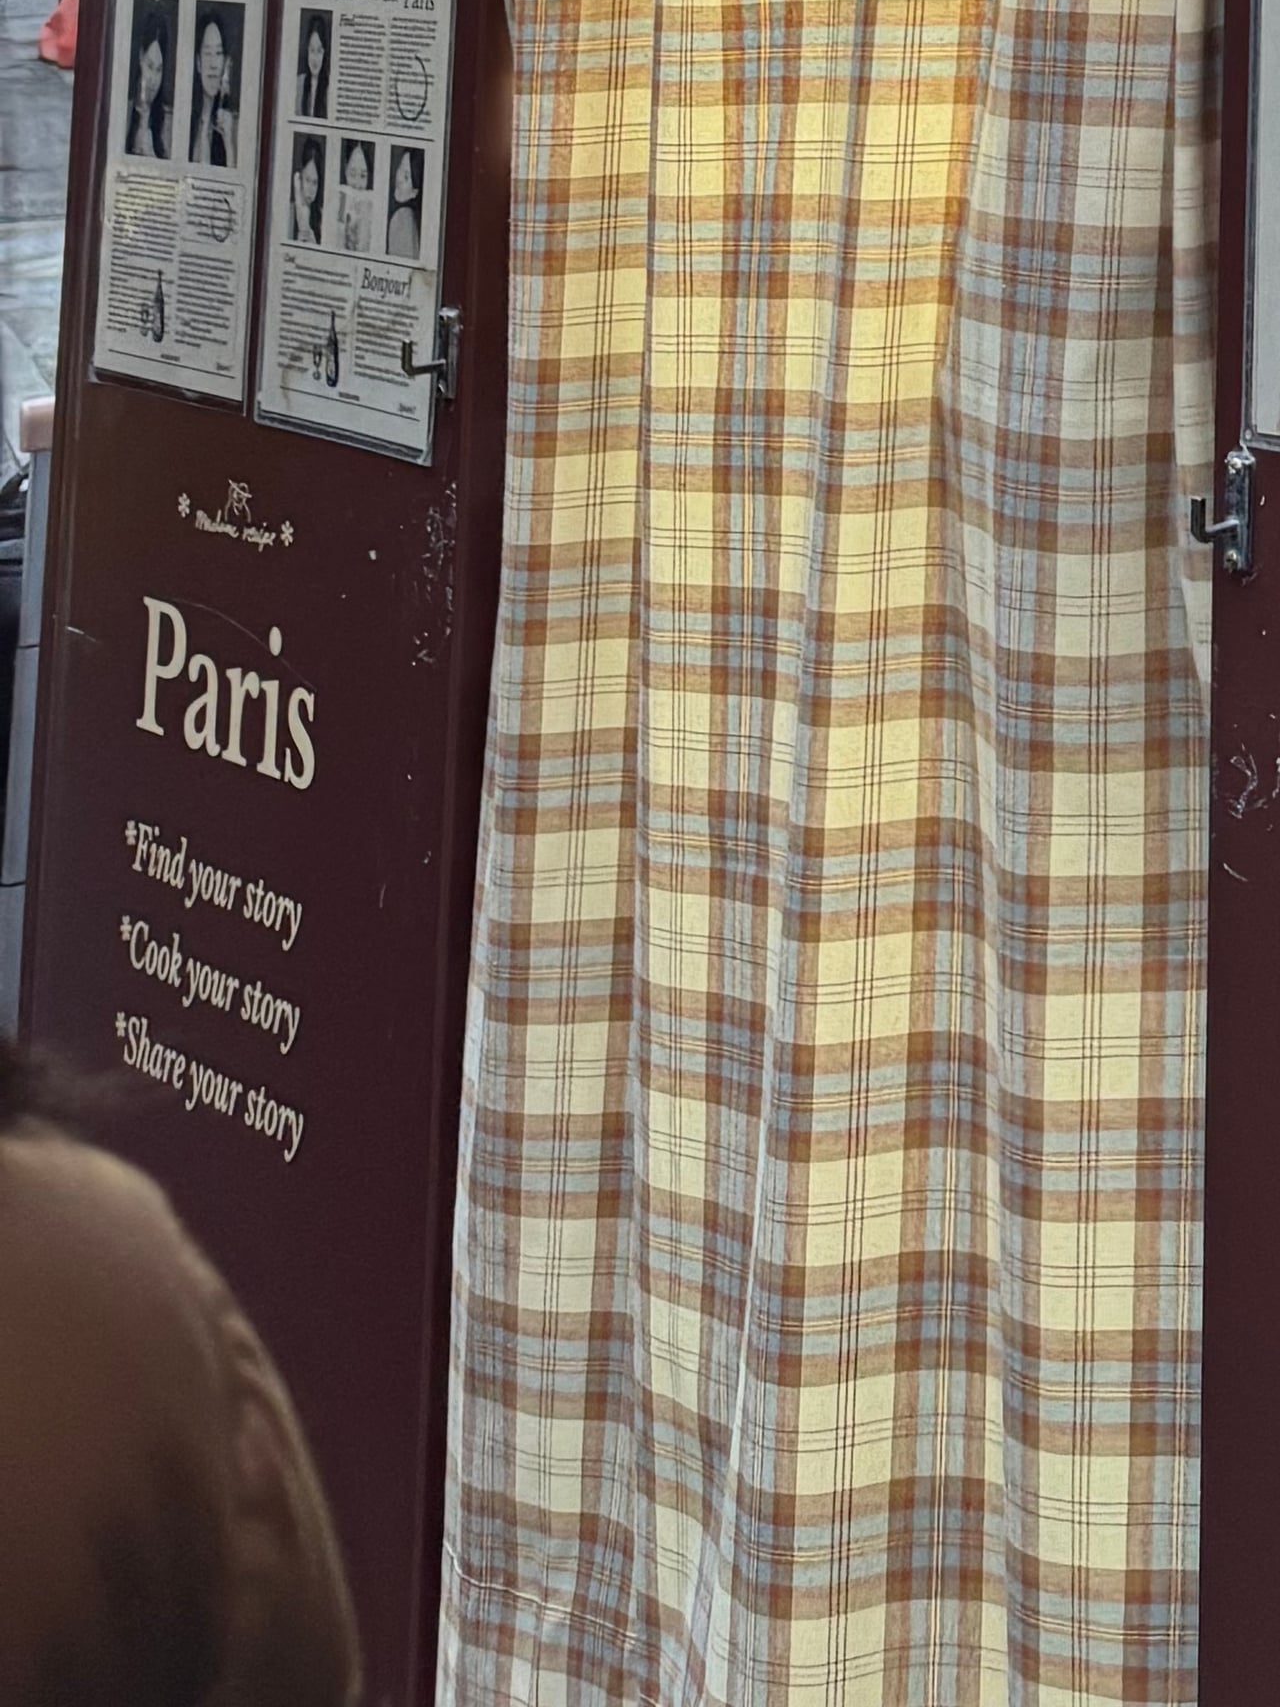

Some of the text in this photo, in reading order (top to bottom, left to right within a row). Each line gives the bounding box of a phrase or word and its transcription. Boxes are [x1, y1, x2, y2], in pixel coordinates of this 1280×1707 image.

[136, 595, 317, 790] Paris
[184, 857, 242, 910] your
[243, 878, 303, 952] story
[182, 957, 240, 1011] your
[241, 980, 301, 1056] story
[185, 1060, 243, 1117] your
[244, 1086, 305, 1164] story
